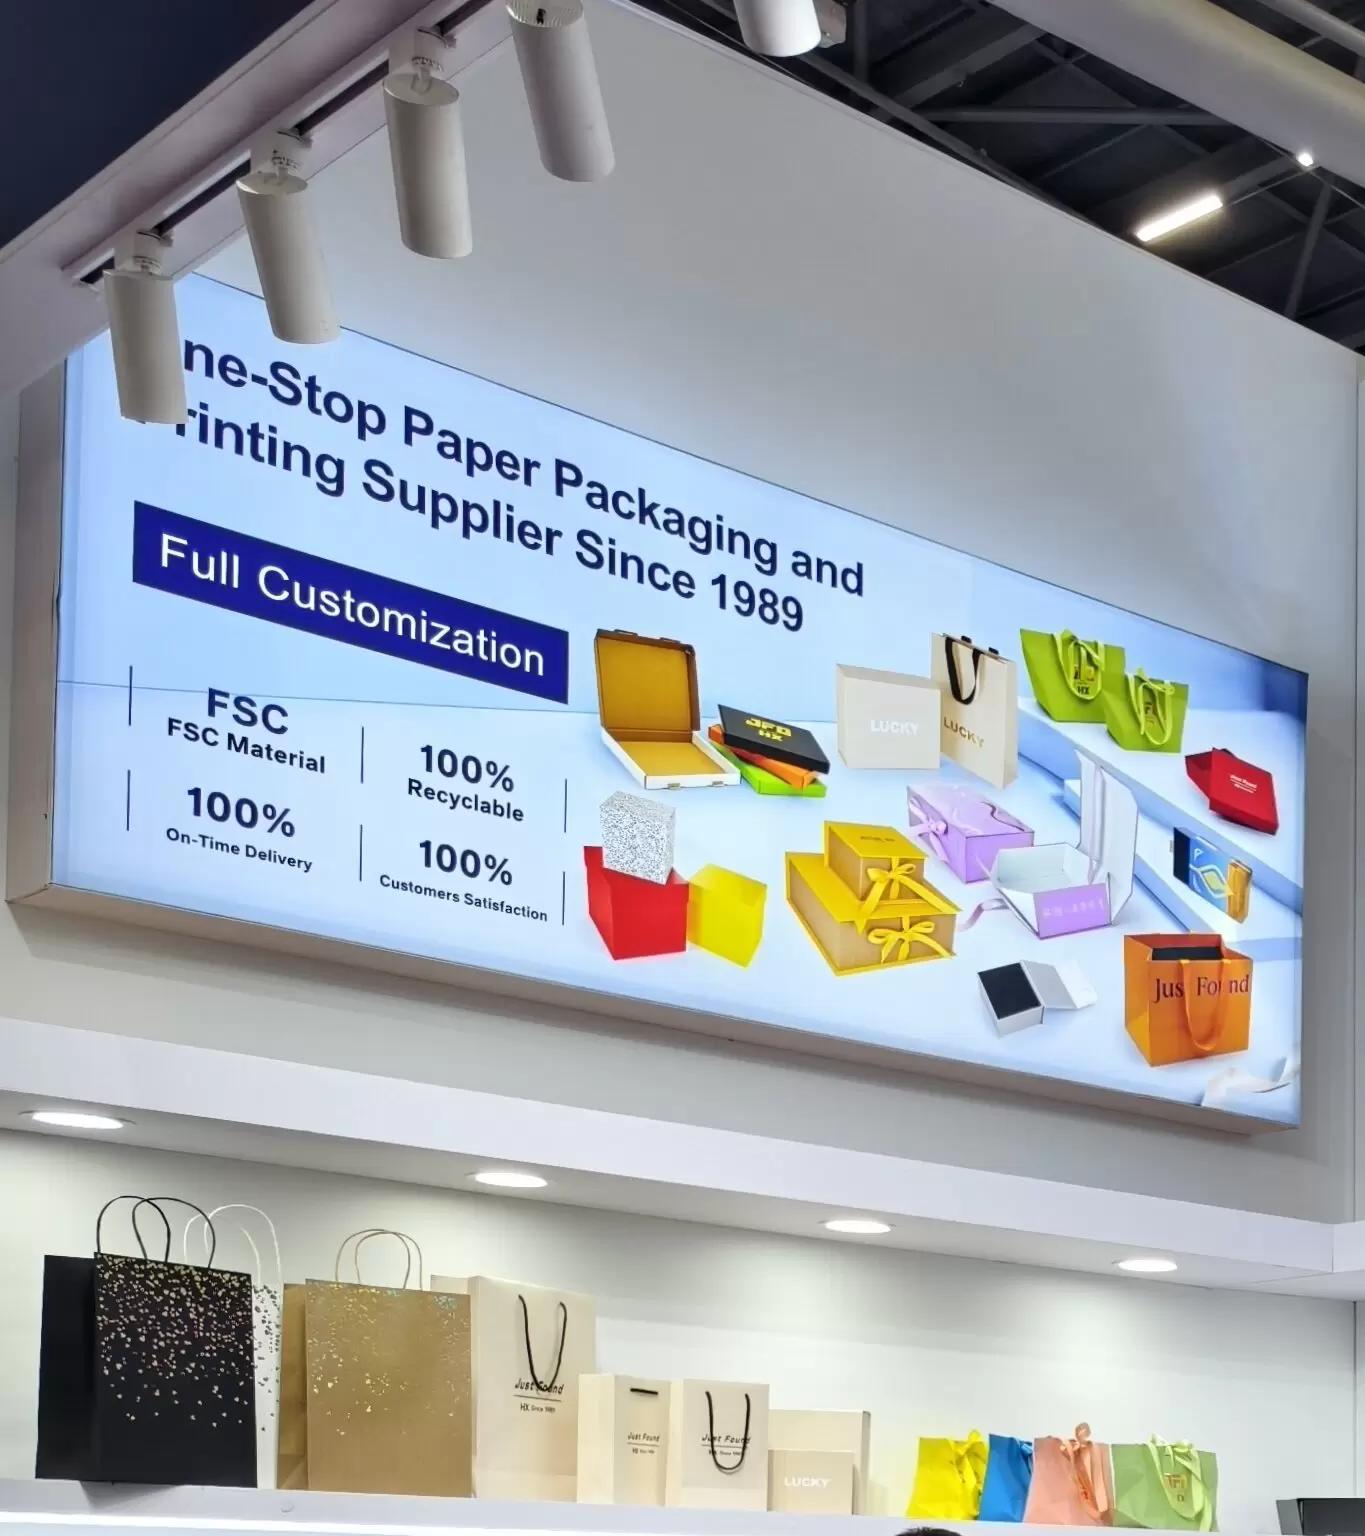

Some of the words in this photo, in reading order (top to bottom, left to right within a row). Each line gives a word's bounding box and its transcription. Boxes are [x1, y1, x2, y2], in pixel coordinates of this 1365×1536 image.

[185, 340, 386, 441] ne-Stop
[404, 405, 541, 486] Paper
[555, 459, 777, 576] Packaging
[792, 551, 863, 596] and
[176, 402, 344, 497] rinting
[363, 459, 562, 555] Supplier
[576, 529, 695, 598] Since
[712, 574, 803, 631] 1989
[162, 534, 240, 588] Full
[259, 566, 543, 676] Customization
[208, 688, 288, 734] FSC
[871, 719, 920, 736] LUCKY
[943, 718, 985, 748] LUCKY
[168, 717, 219, 746] FSC
[228, 733, 324, 773] Material
[421, 745, 513, 792] 100%
[188, 787, 294, 837] 100%
[408, 778, 523, 821] Recyclable
[167, 828, 240, 854] On-Time
[246, 845, 312, 872] Delivery
[420, 840, 512, 885] 100%
[380, 875, 459, 902] Customers
[464, 893, 547, 921] Satisfaction
[1154, 978, 1184, 1004] Jus
[1196, 974, 1249, 997] Fond
[515, 1378, 533, 1391] Just
[784, 1477, 832, 1488] LUCKY
